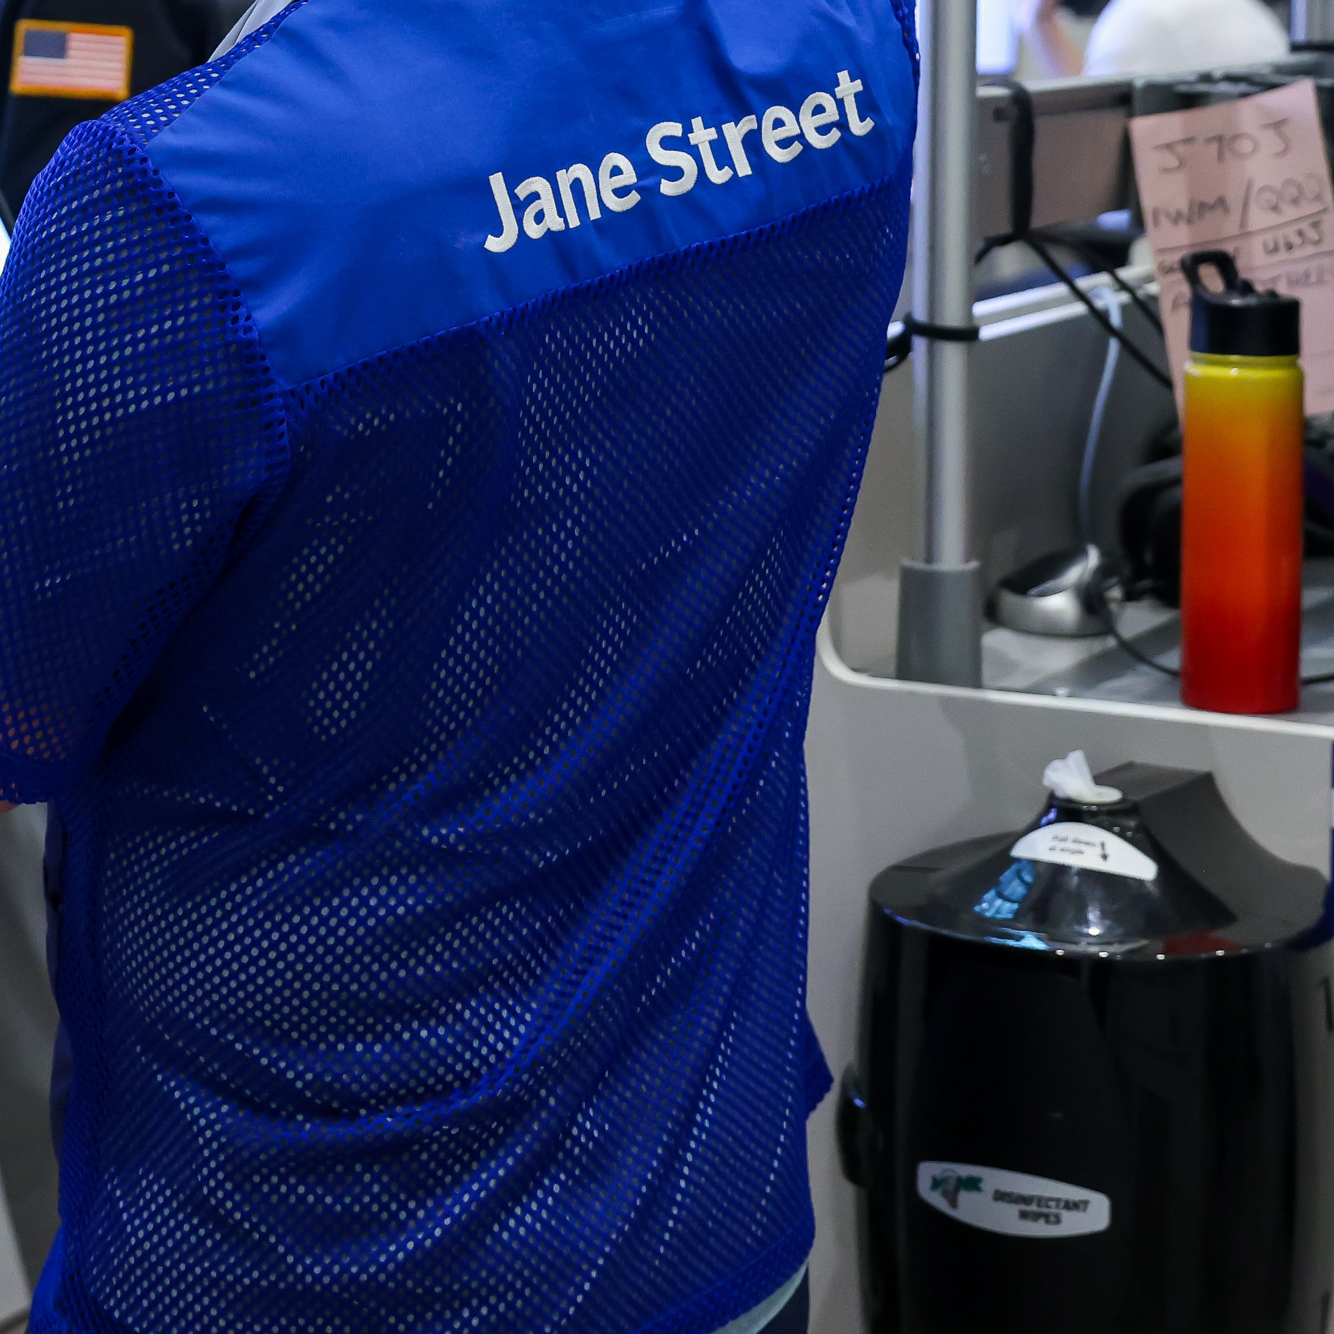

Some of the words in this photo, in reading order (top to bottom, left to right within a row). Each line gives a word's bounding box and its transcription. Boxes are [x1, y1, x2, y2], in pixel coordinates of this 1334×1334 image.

[483, 152, 642, 254] Jane
[645, 69, 875, 196] Street
[992, 1188, 1091, 1213] DISINFECTANT
